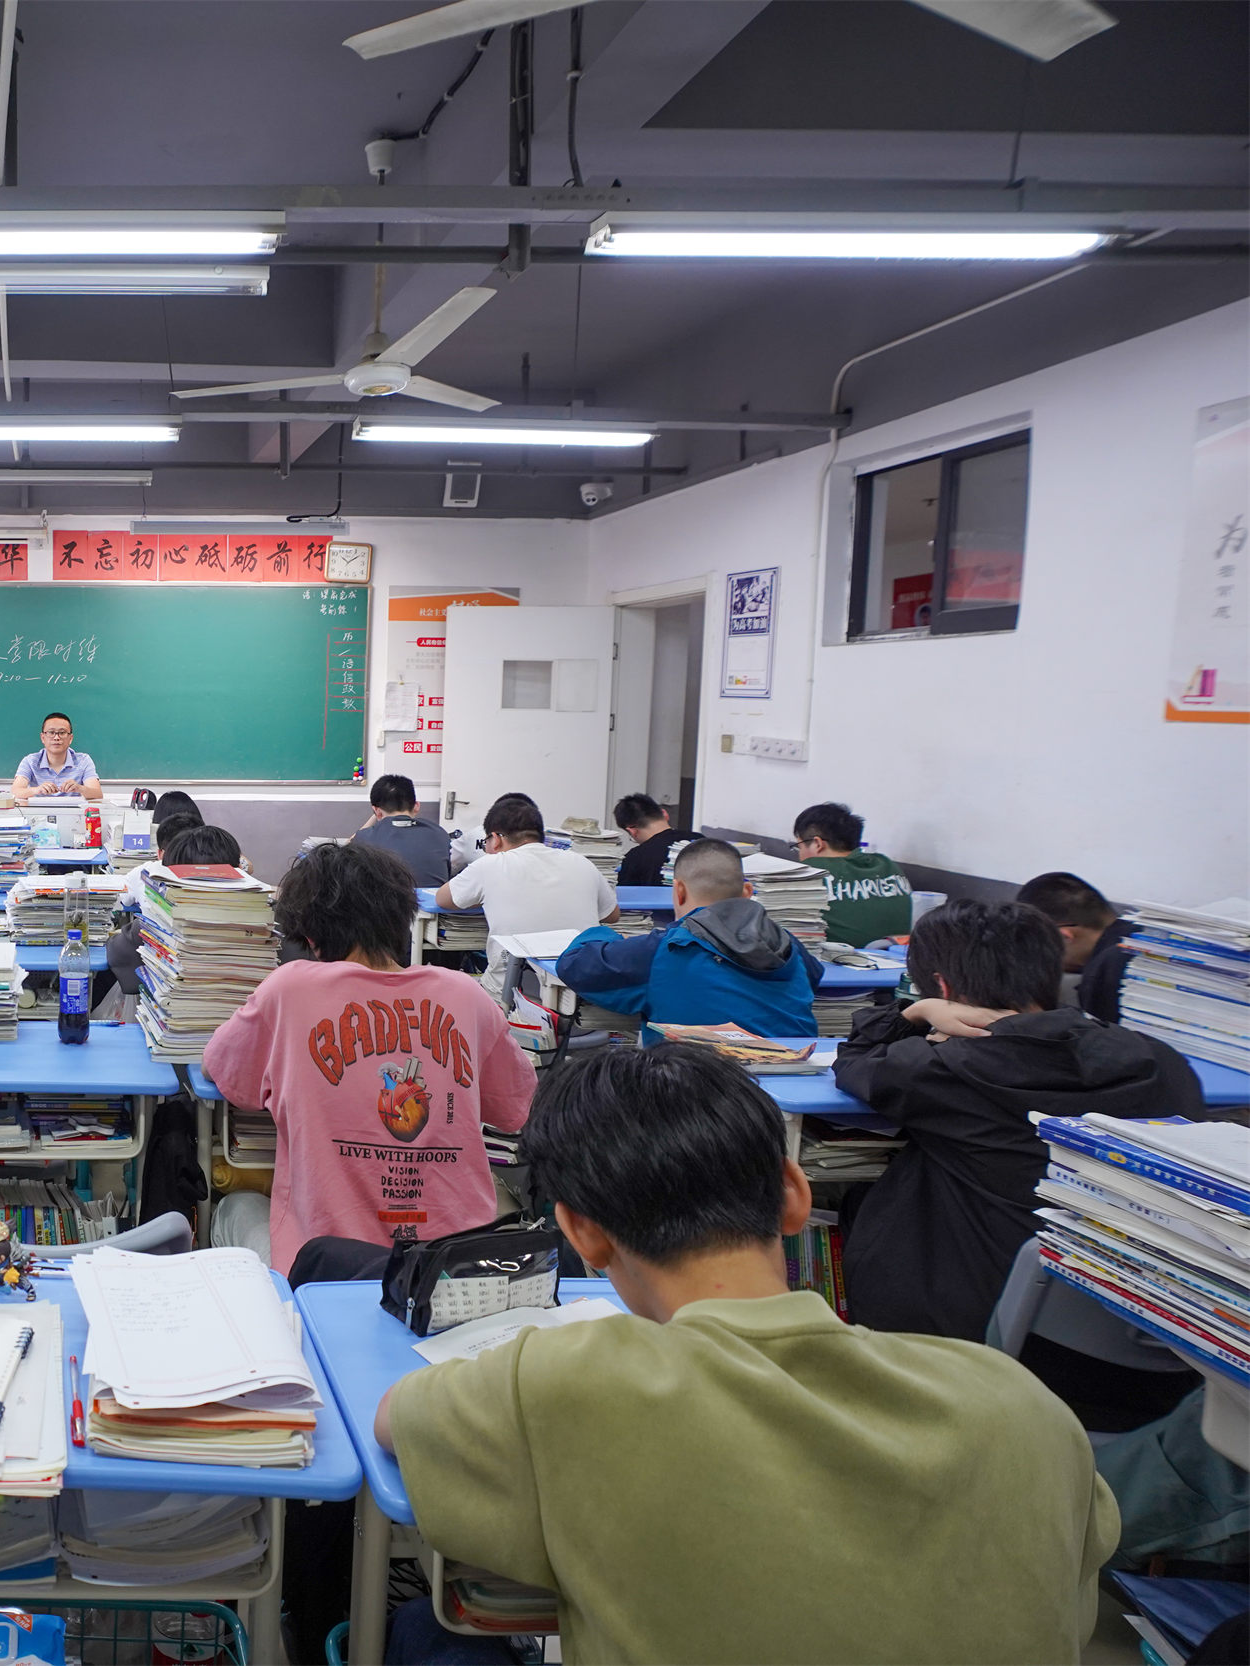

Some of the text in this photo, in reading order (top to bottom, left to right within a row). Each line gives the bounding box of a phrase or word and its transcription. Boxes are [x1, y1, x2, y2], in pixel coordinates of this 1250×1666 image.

[59, 538, 326, 577] 不忘初心砥砺前行
[404, 742, 422, 752] 公民
[132, 838, 143, 846] 14
[308, 998, 473, 1088] BADFIVE
[339, 1145, 457, 1163] LIVE WITH HOOPS
[388, 1165, 420, 1175] VISION
[381, 1175, 424, 1187] DECISION
[382, 1187, 422, 1199] PASSION
